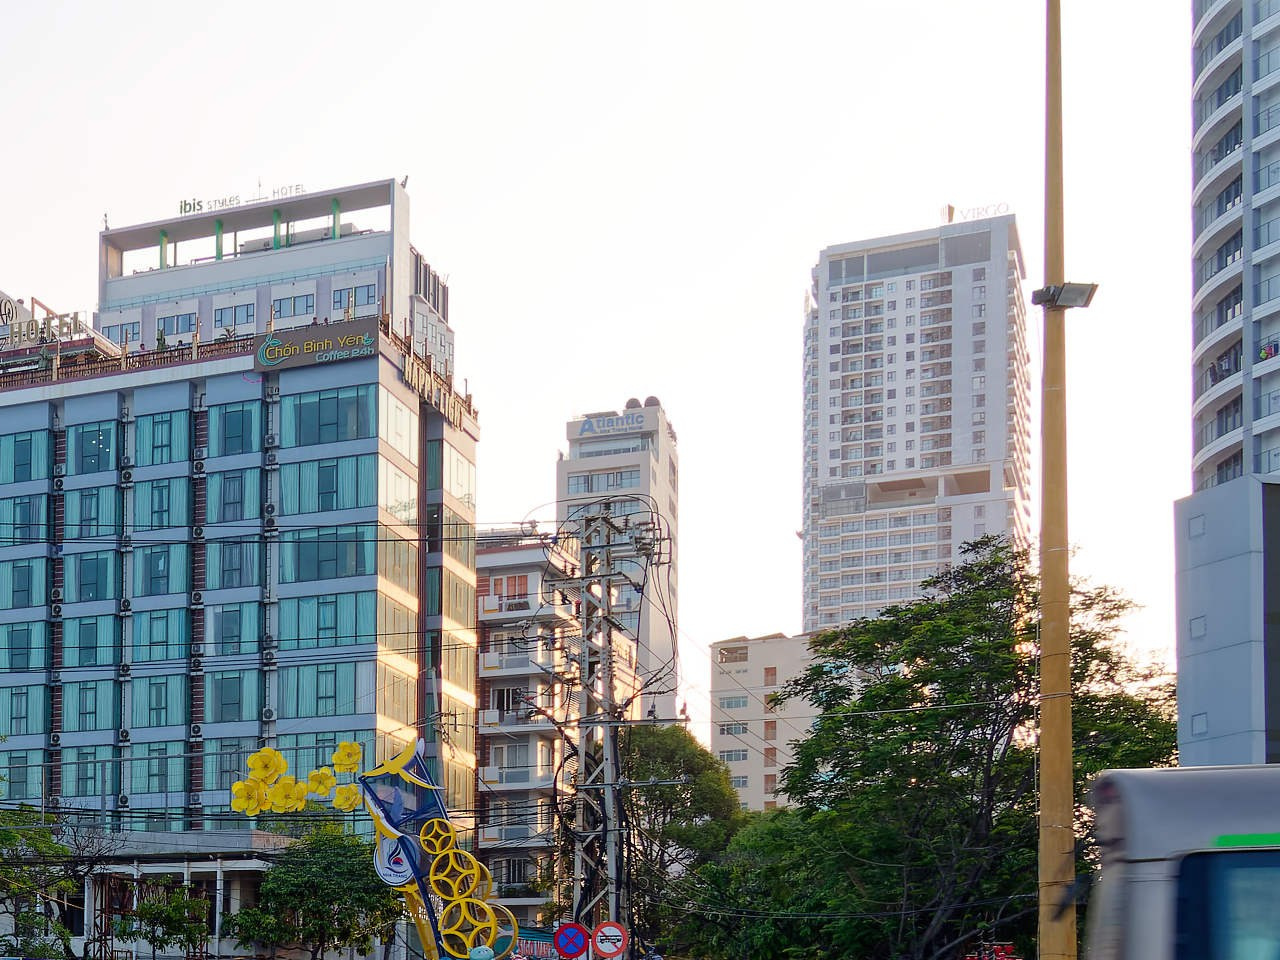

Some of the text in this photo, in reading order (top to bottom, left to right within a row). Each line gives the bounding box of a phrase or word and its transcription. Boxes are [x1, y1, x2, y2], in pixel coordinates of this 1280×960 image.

[180, 198, 203, 214] ibis
[272, 184, 306, 198] HOTEL
[960, 203, 1009, 220] VIRGO
[9, 311, 83, 346] HOTEL
[266, 341, 299, 359] Chốn
[315, 350, 350, 362] Coffee
